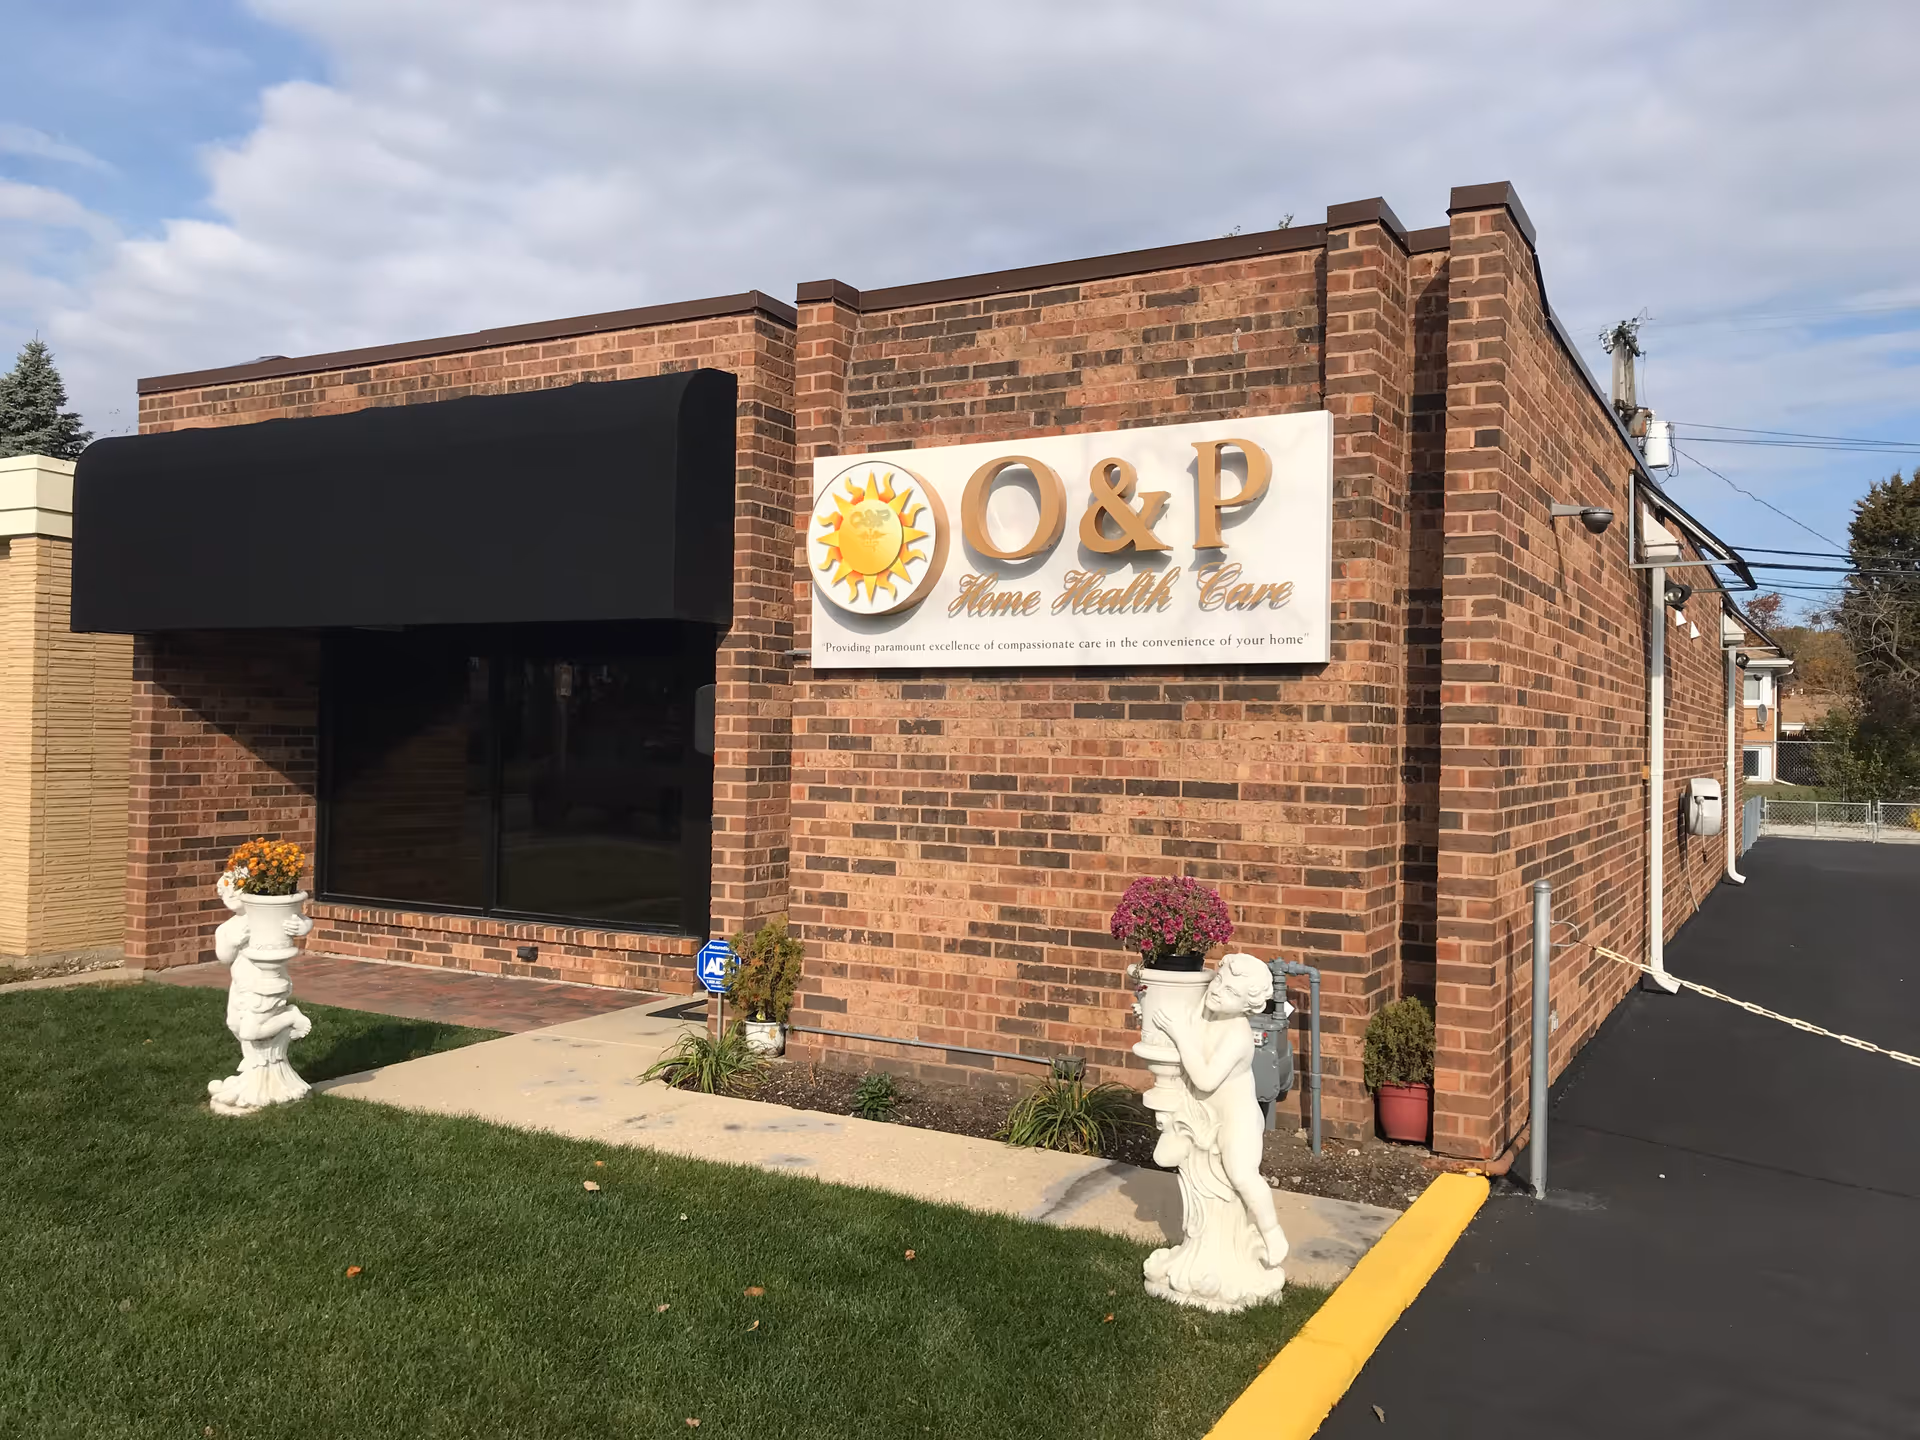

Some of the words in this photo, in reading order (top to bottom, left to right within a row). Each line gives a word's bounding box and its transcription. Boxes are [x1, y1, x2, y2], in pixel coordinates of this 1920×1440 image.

[948, 572, 1041, 612] Home
[1051, 566, 1181, 609] Health
[1197, 562, 1296, 606] Care
[874, 643, 926, 654] paramount
[929, 640, 980, 651] excellence
[984, 640, 995, 651] of
[998, 640, 1075, 652] compassionate
[1078, 640, 1101, 649] care
[1106, 639, 1116, 648] in
[1120, 637, 1138, 648] the
[1142, 637, 1215, 647] convenience
[1219, 634, 1233, 646] of
[1236, 636, 1265, 648] your
[705, 957, 736, 976] AD
